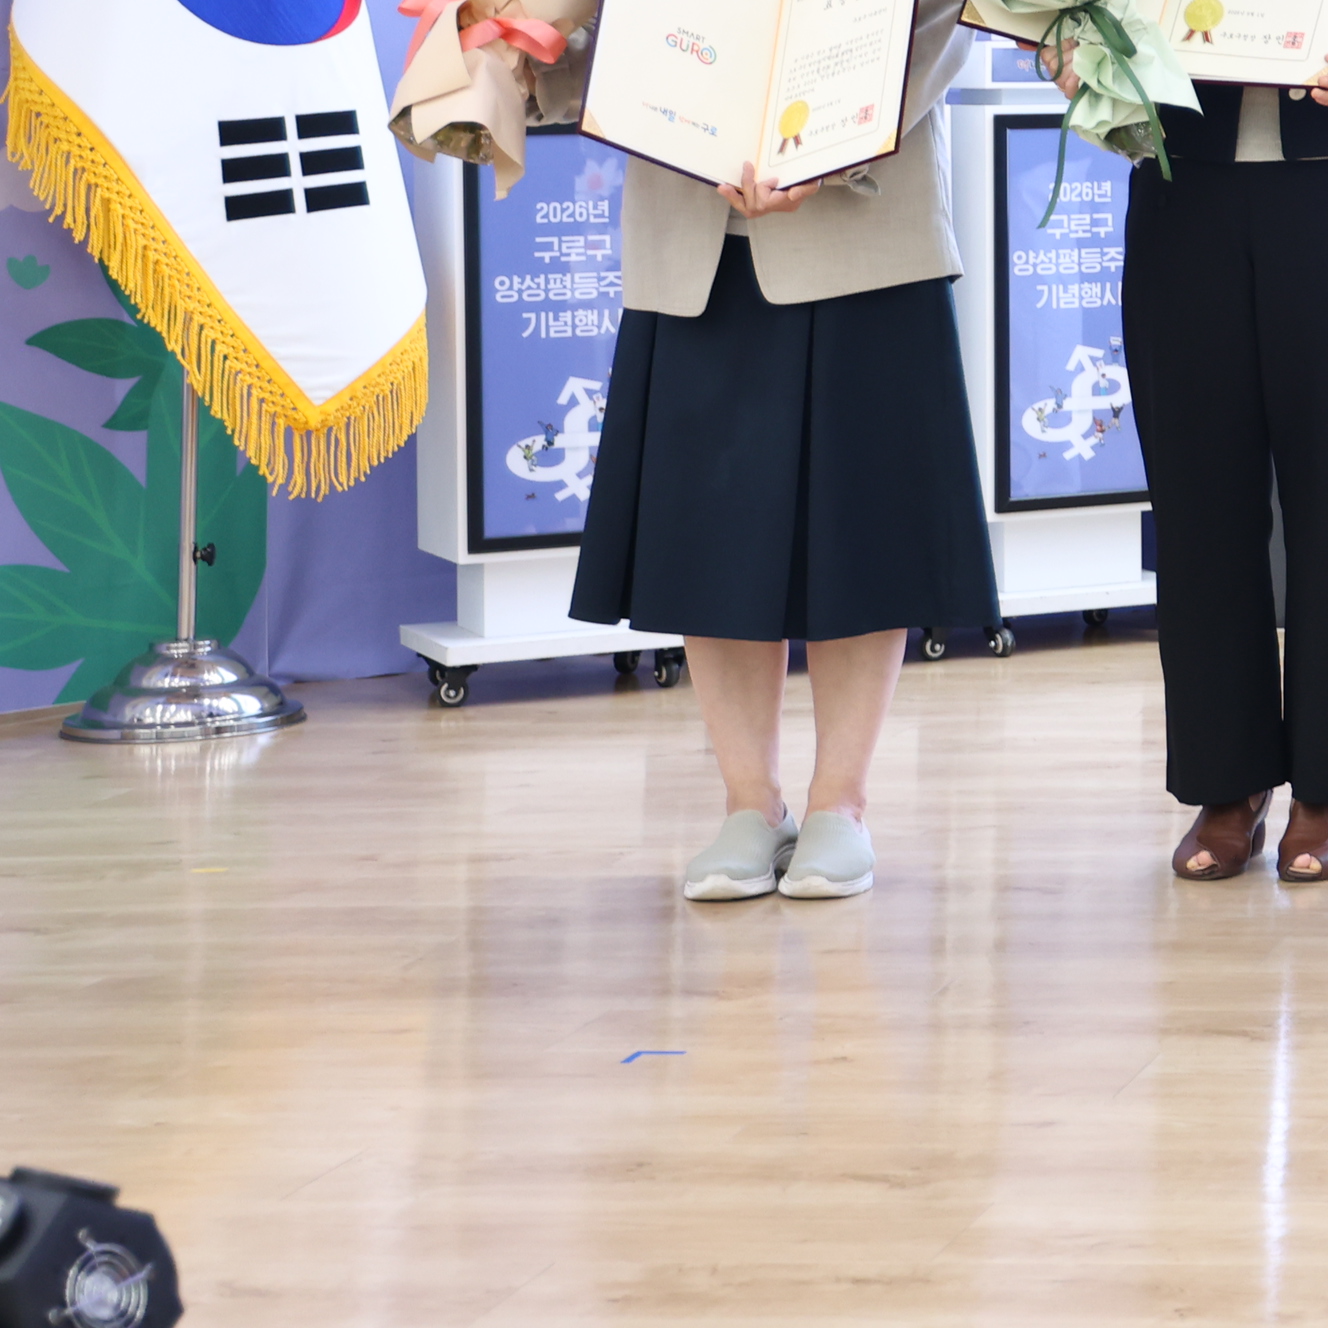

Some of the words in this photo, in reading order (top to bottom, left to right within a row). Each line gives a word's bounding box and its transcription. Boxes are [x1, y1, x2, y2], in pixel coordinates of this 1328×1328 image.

[536, 199, 610, 223] 2026년
[1046, 213, 1115, 239] 구로구
[534, 234, 613, 263] 구로구
[1013, 246, 1124, 276] 양성평등주
[494, 273, 622, 304] 양성평등주
